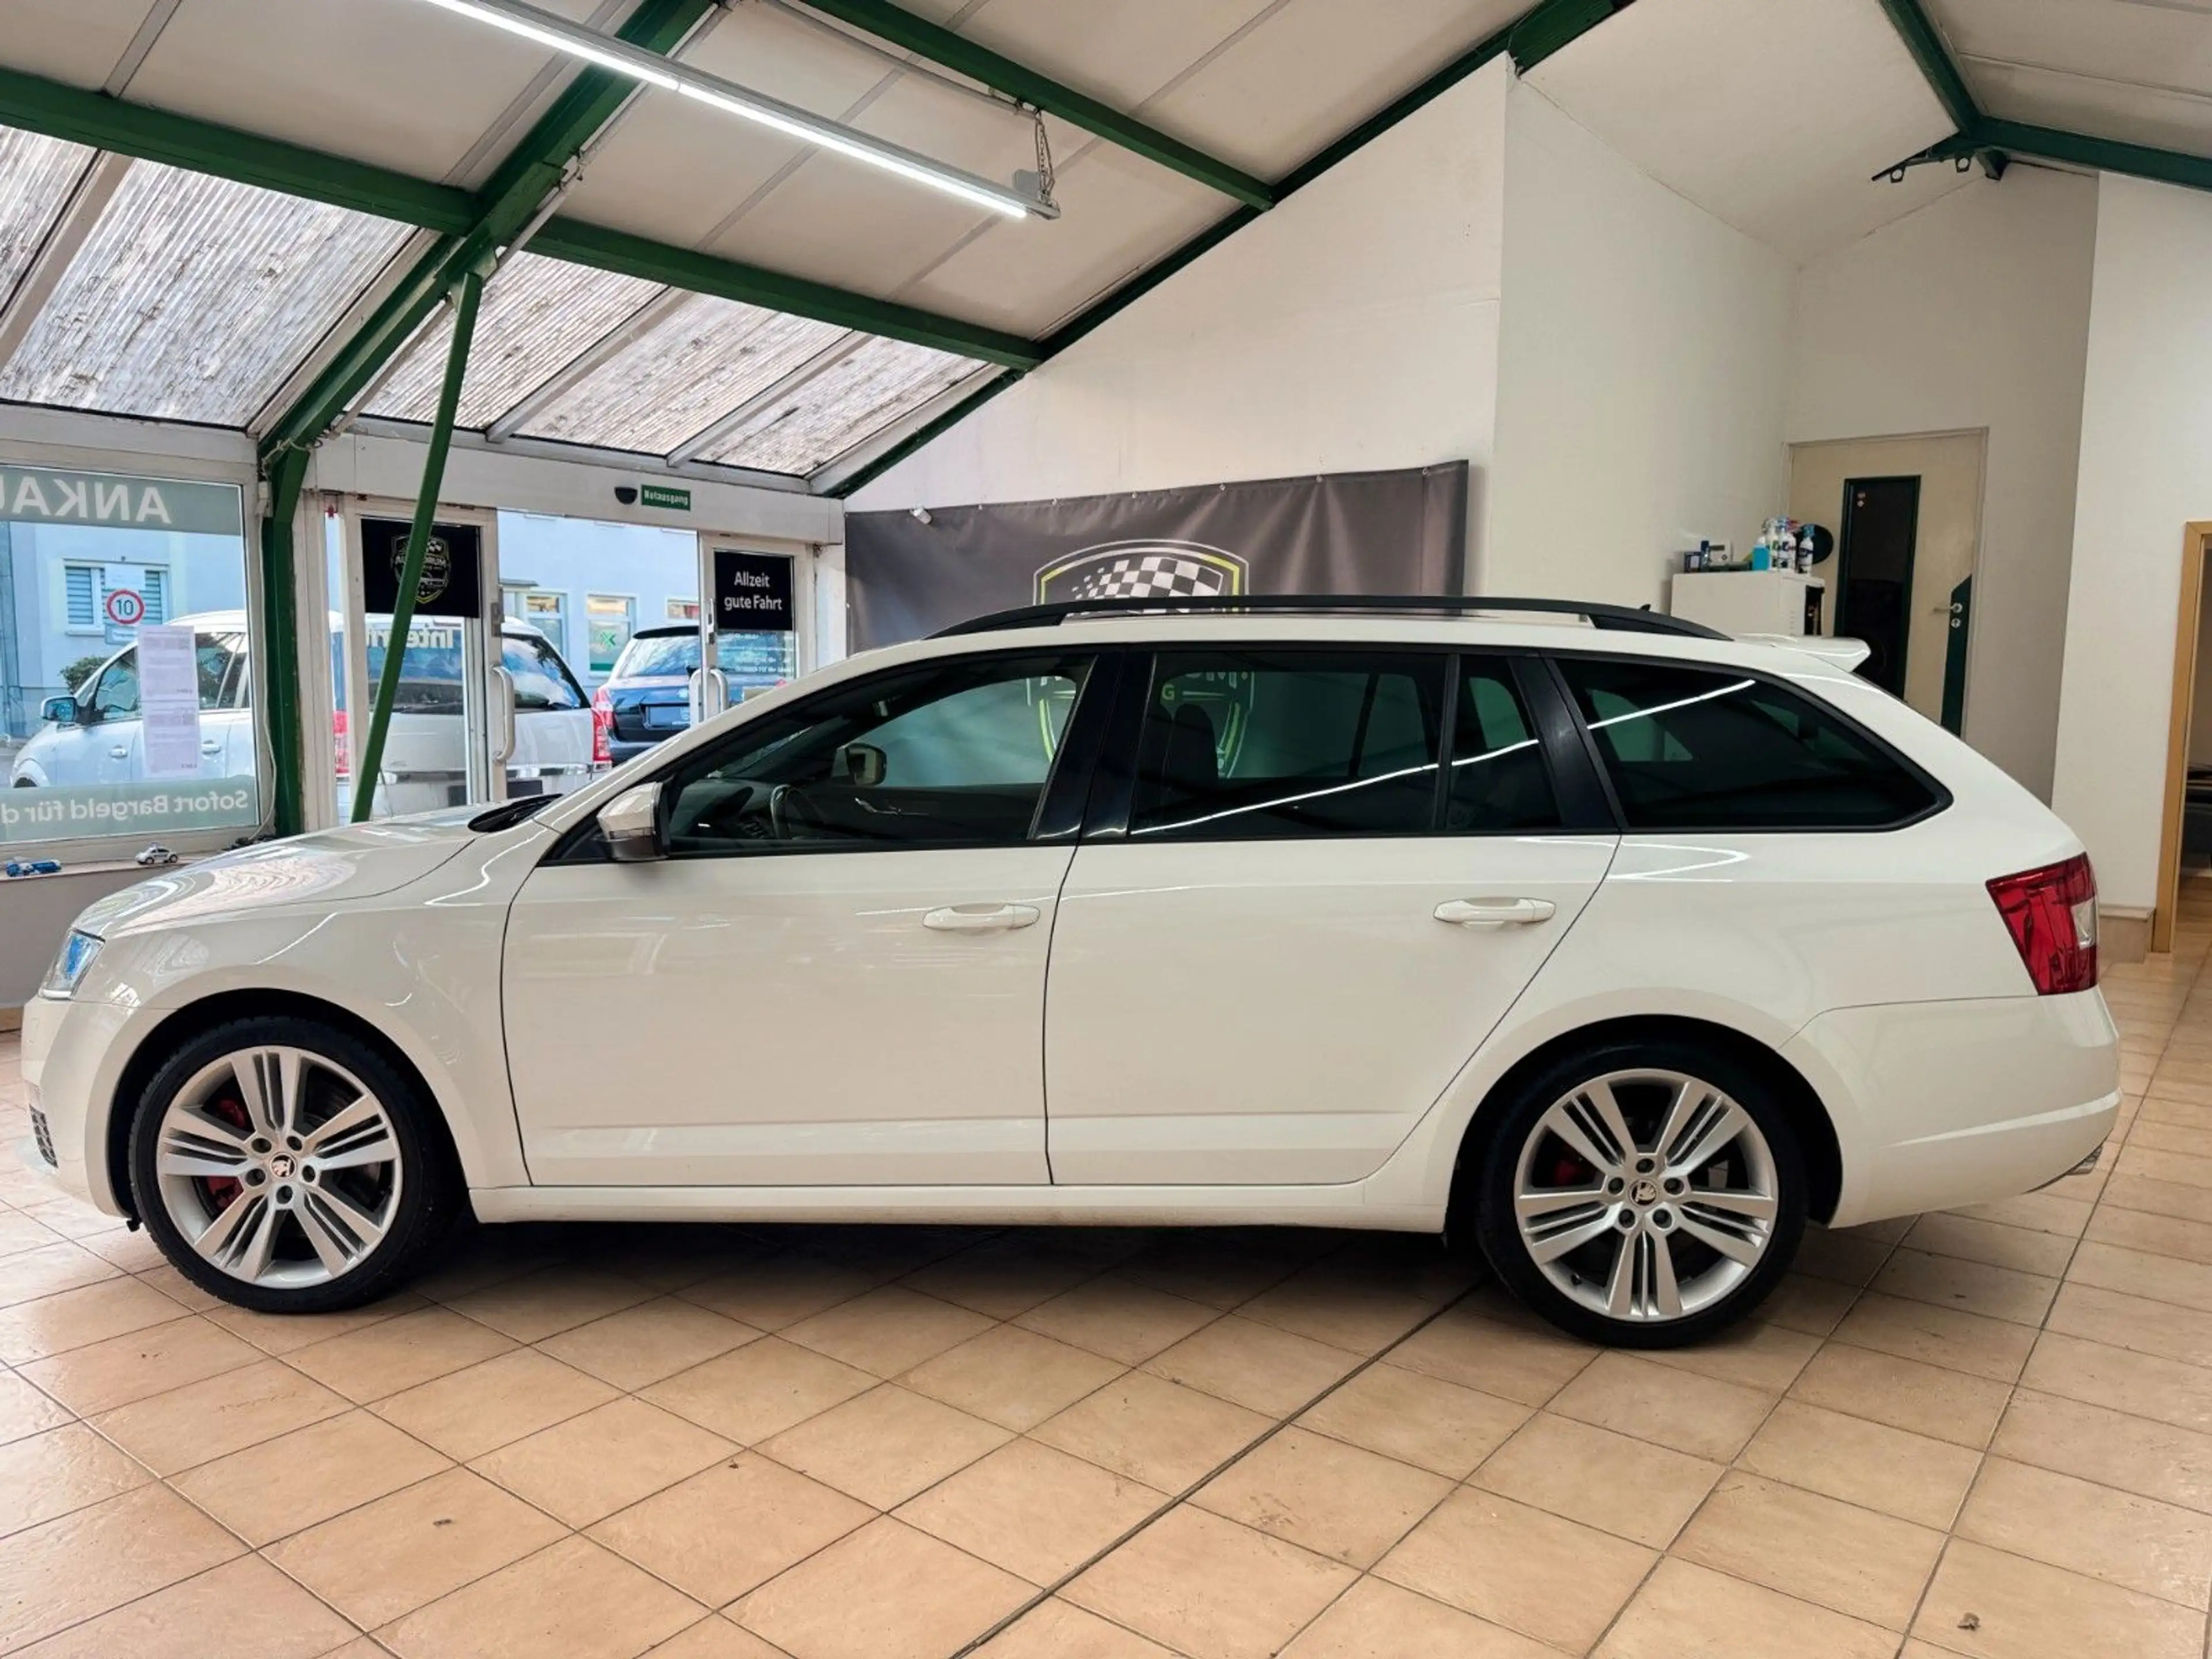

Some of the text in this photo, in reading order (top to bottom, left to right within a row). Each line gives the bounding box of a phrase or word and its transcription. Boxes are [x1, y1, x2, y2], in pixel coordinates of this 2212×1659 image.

[734, 571, 770, 588] Allzeit
[116, 600, 134, 616] 10
[724, 594, 782, 611] gute Fahrt
